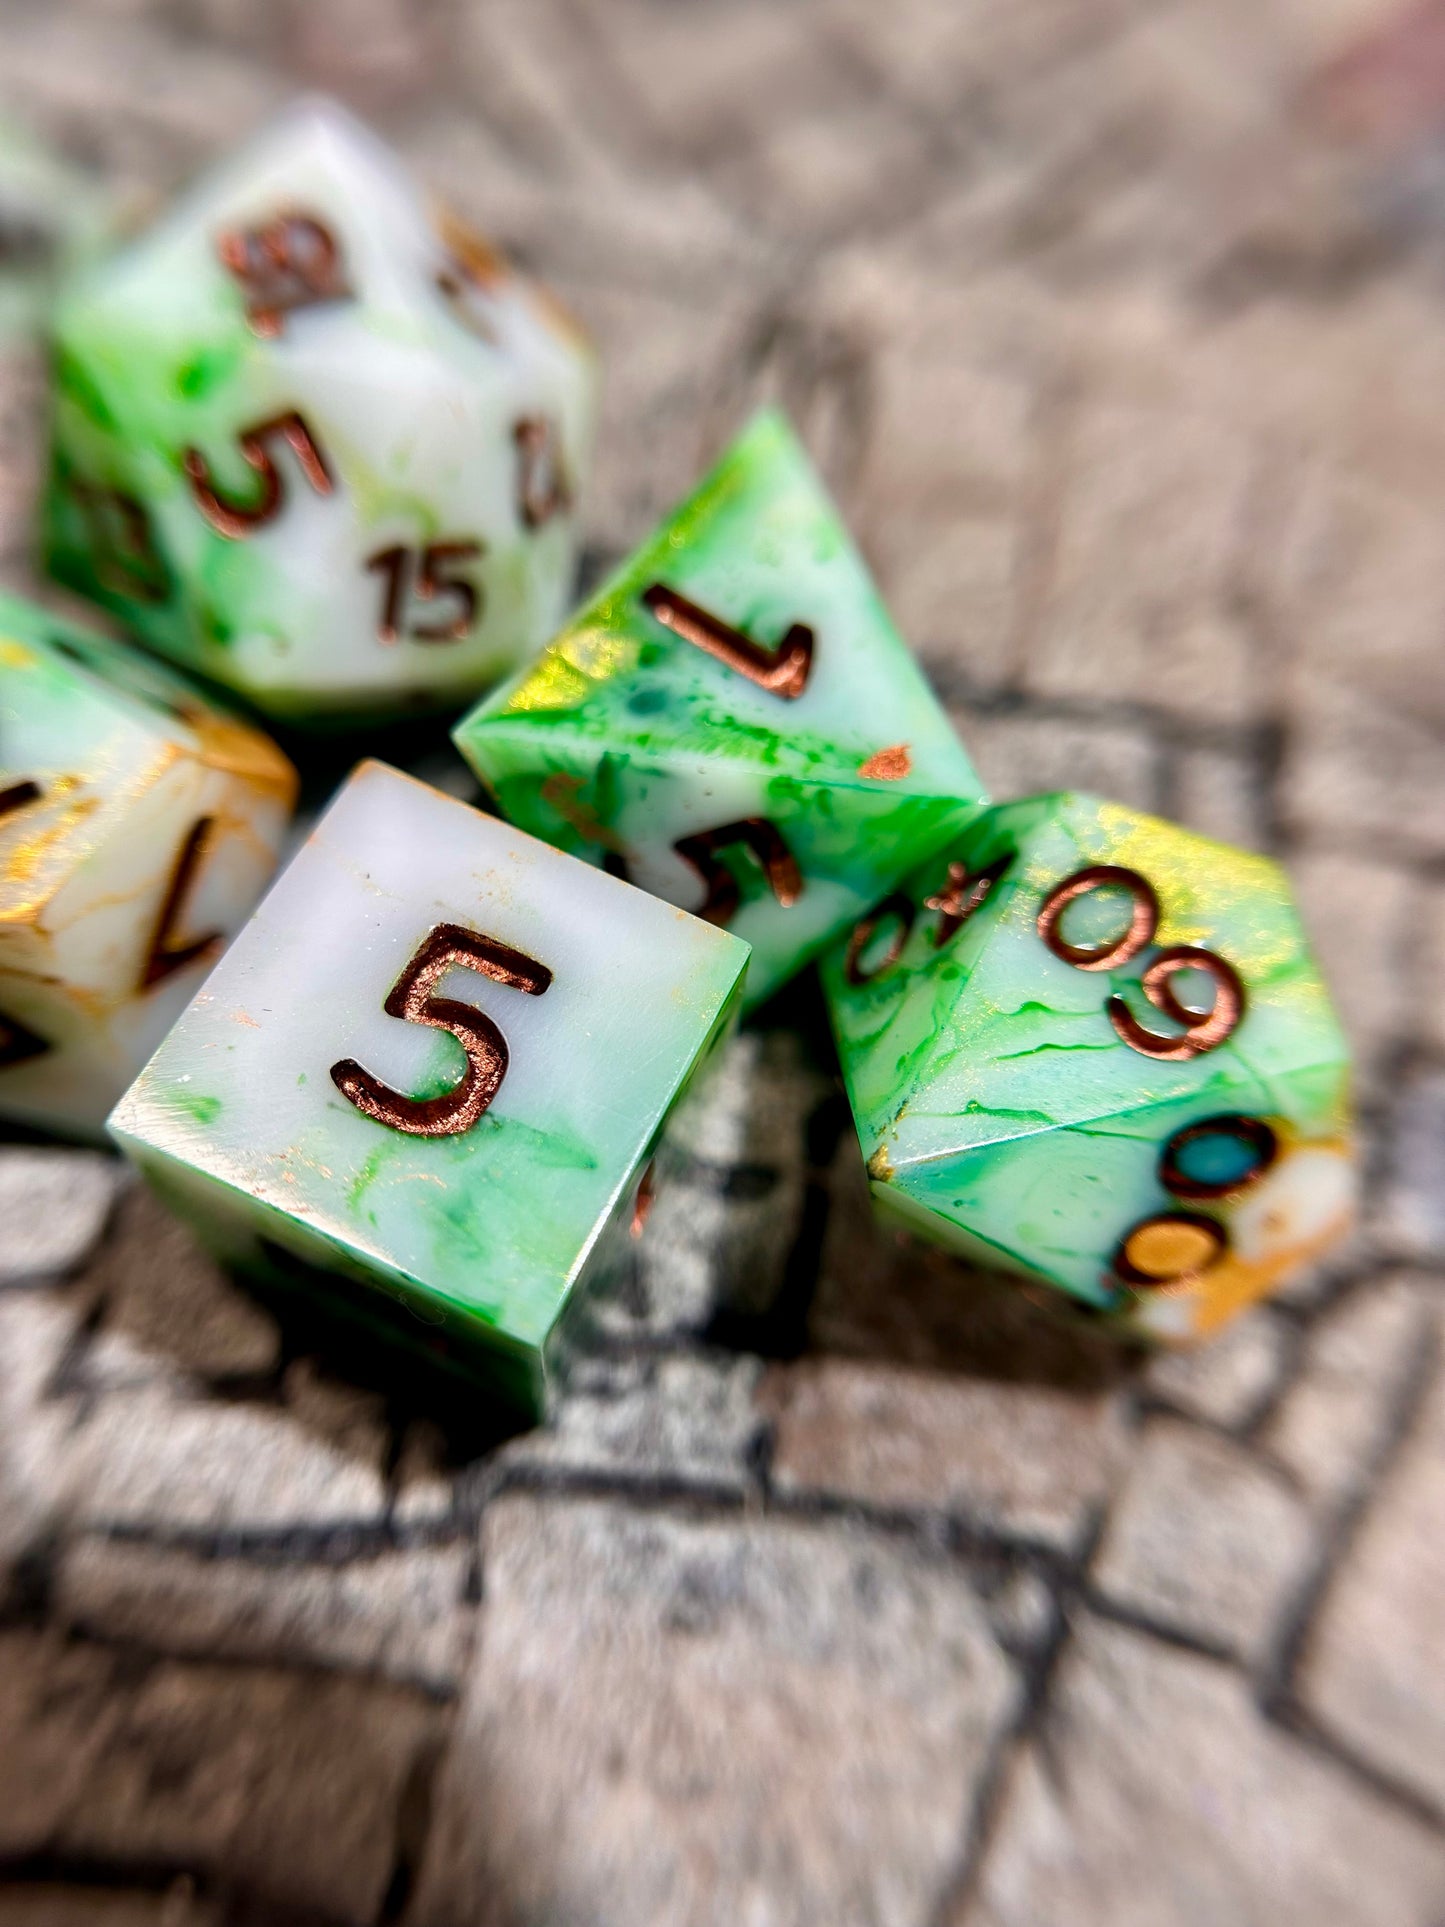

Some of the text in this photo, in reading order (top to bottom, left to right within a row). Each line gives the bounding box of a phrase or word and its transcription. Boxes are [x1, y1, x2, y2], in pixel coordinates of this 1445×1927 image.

[182, 409, 334, 541] 5
[366, 540, 485, 645] 15
[329, 922, 554, 1138] 5
[1111, 1112, 1279, 1290] 00
